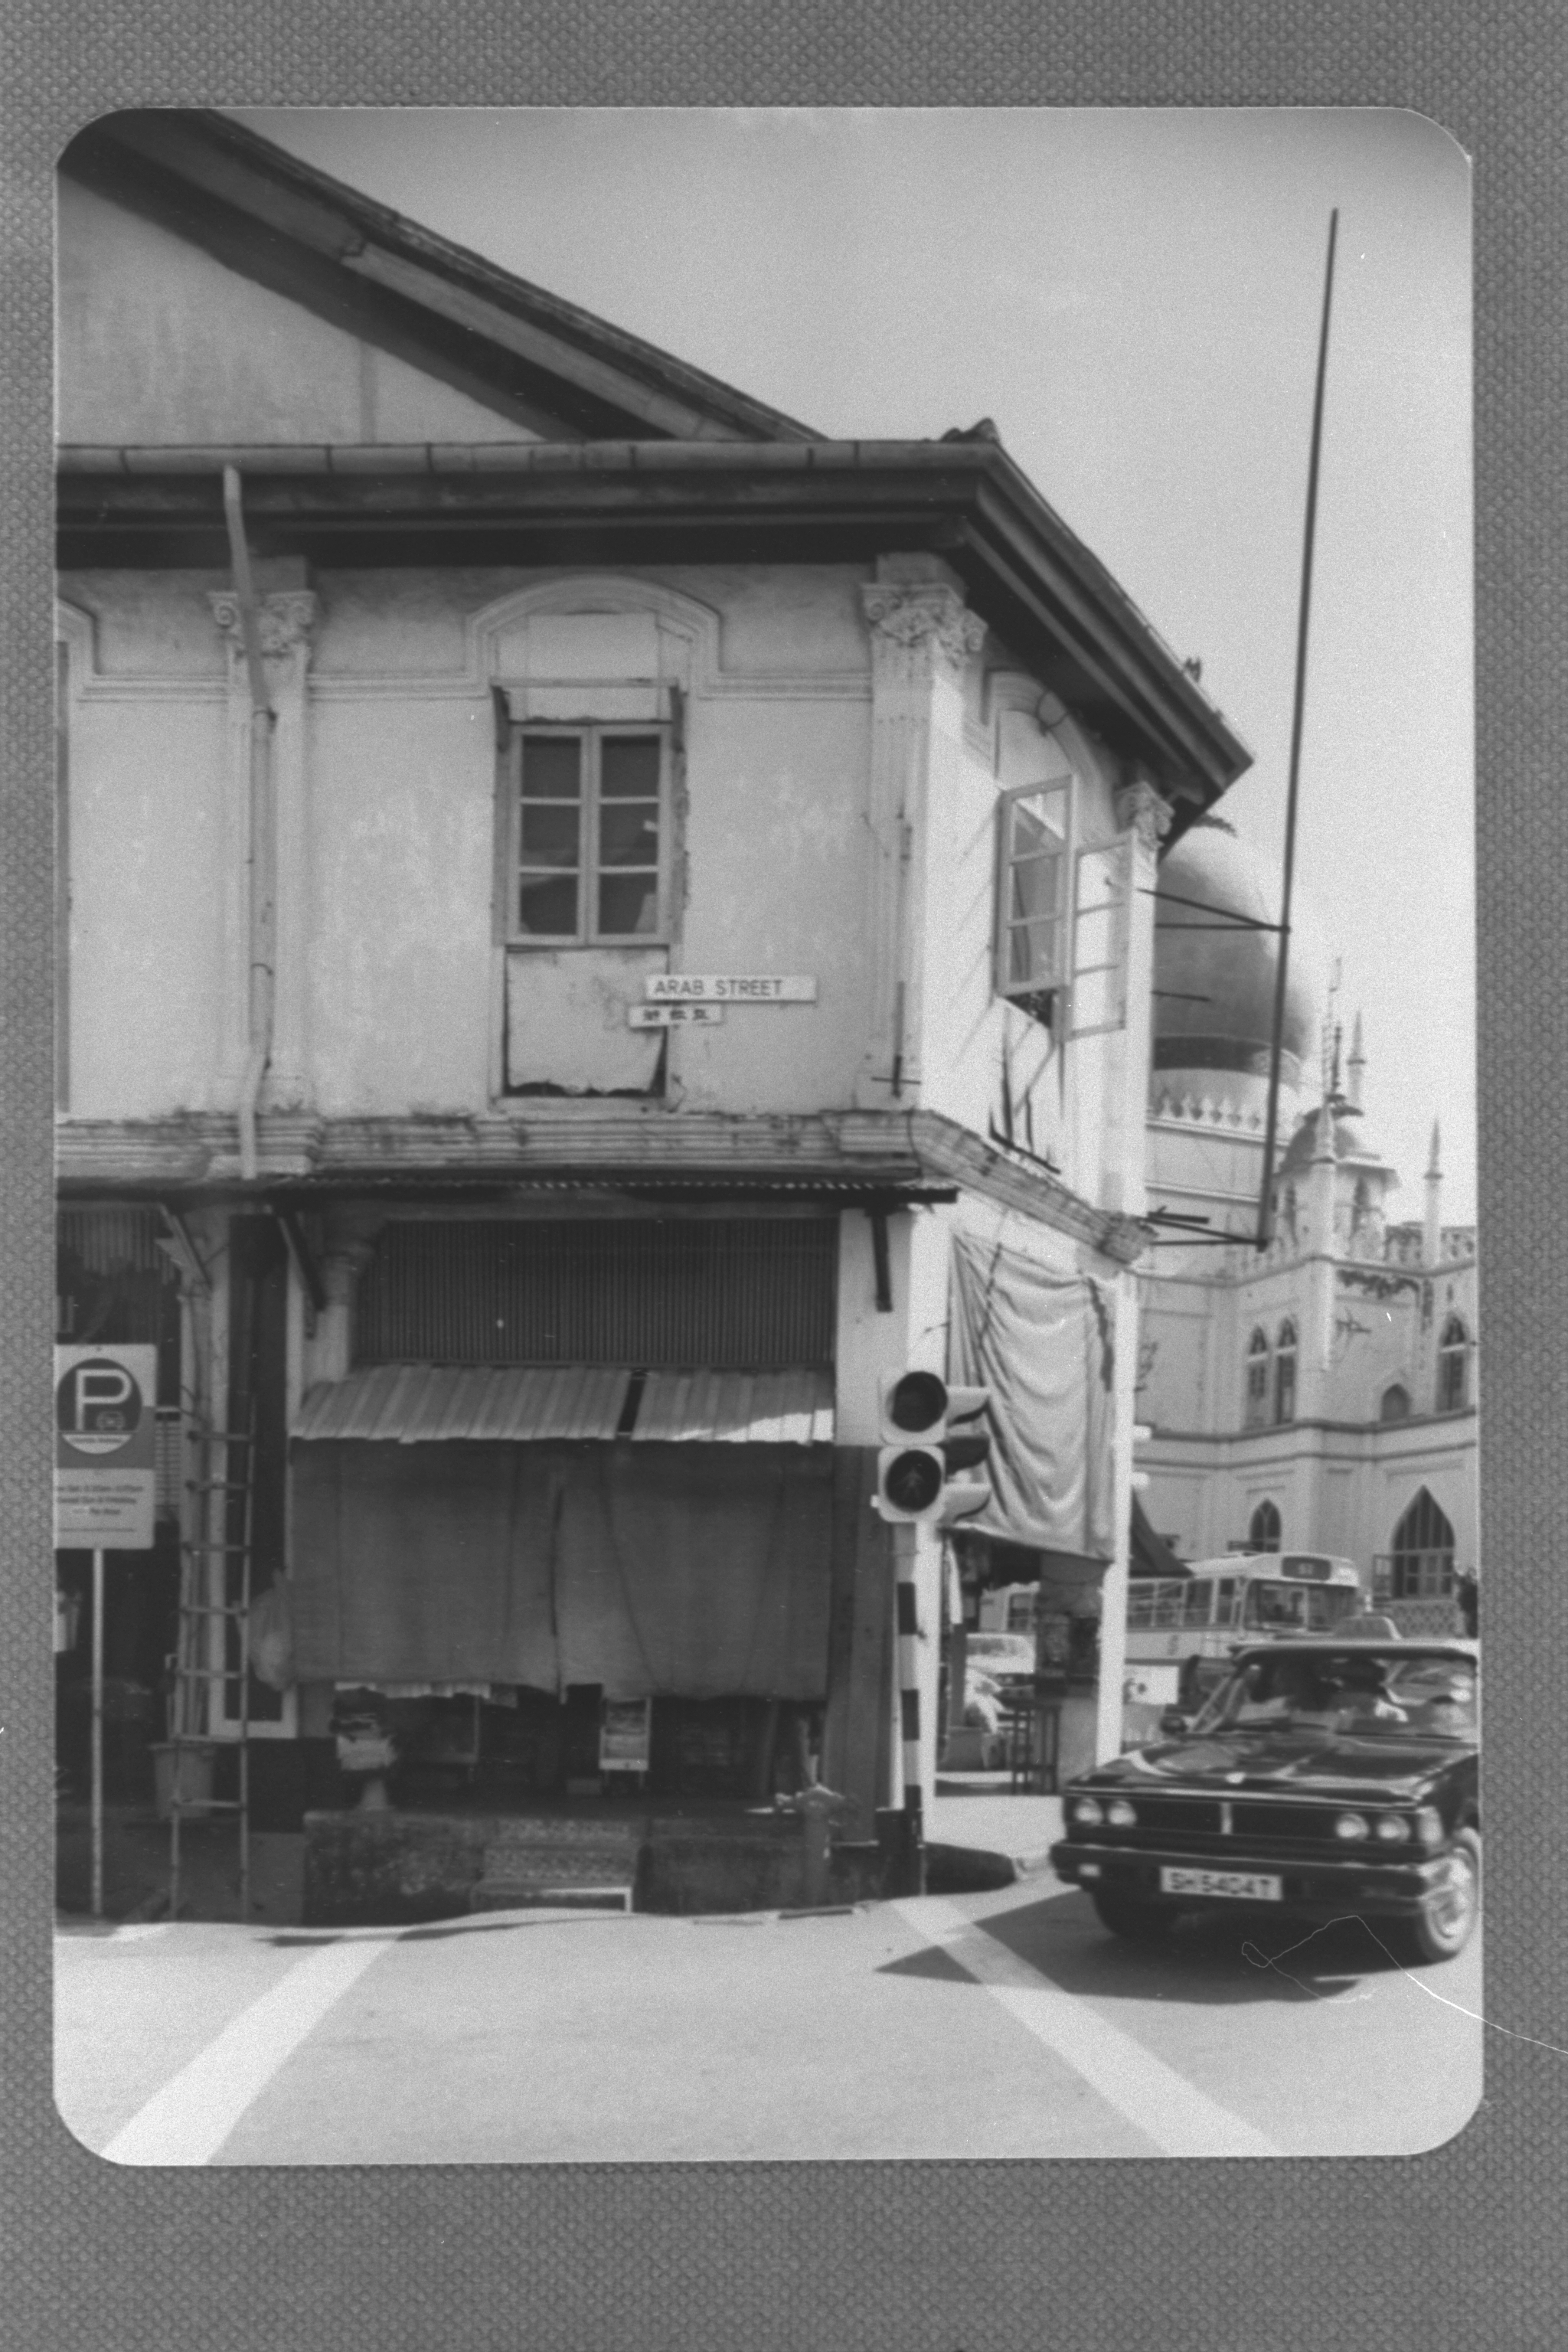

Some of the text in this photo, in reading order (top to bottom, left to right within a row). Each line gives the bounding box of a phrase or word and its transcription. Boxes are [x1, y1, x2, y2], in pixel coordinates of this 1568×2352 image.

[655, 979, 782, 996] ARAB STREET
[77, 1369, 132, 1432] P
